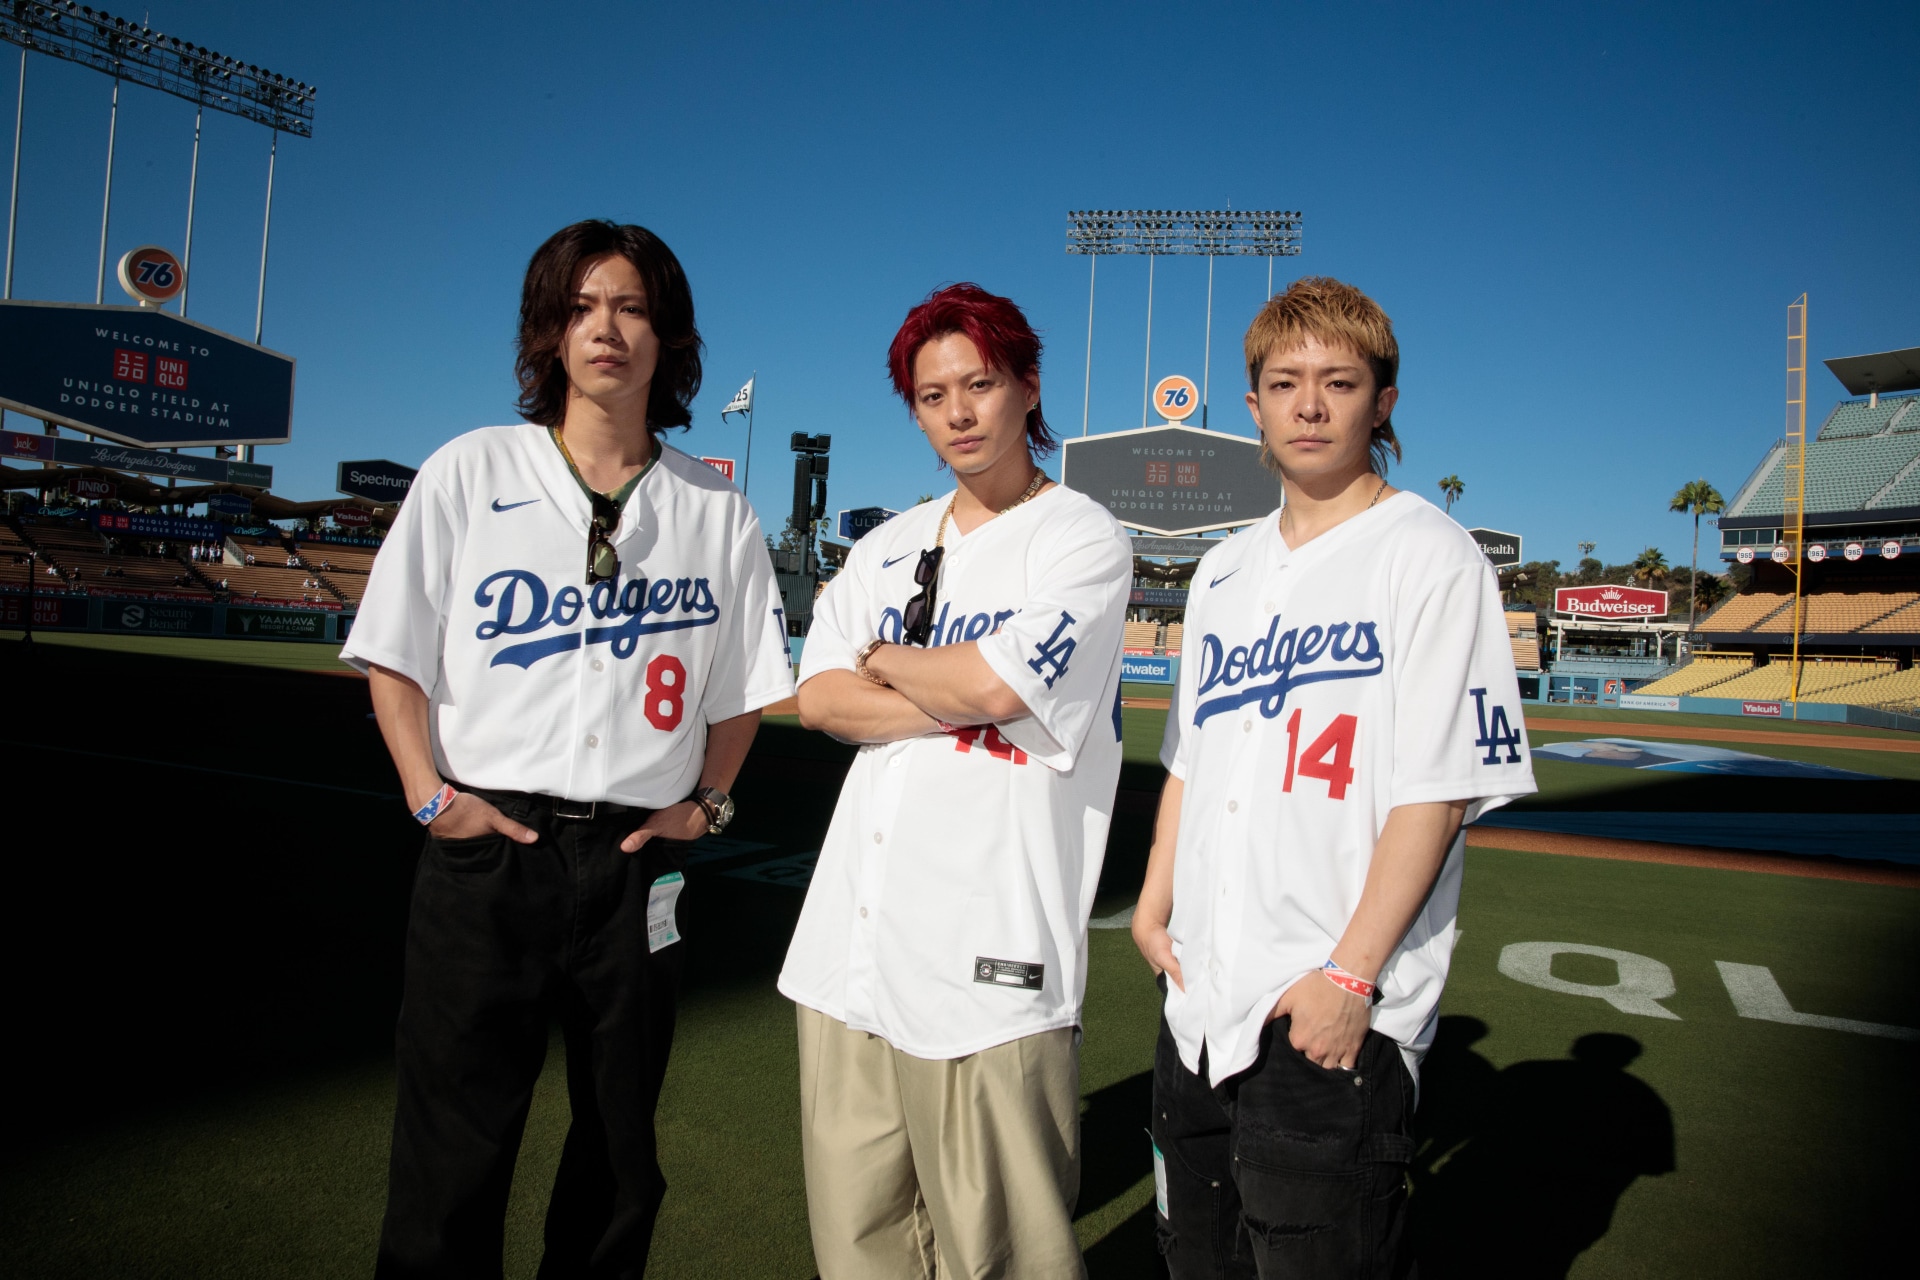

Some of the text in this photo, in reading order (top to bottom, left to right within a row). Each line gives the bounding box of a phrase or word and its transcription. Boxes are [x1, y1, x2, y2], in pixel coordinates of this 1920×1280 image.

[137, 260, 175, 288] 76
[95, 328, 210, 357] WELCOME TO
[159, 360, 183, 374] UNI
[159, 372, 185, 387] QLO
[63, 377, 230, 413] UNIQLO FIELD AT
[1162, 387, 1190, 408] 76
[60, 393, 230, 428] DODGER STADIUM
[14, 436, 39, 451] Jack
[1132, 447, 1215, 457] WELCOME TO
[91, 448, 197, 475] Los Angeles Dodgers
[350, 470, 411, 488] Spectrum
[77, 480, 110, 495] JINRO
[1111, 489, 1164, 499] UNIQLO
[1172, 491, 1209, 500] FIELD
[1110, 501, 1232, 512] DODGER STADIUM
[132, 517, 169, 527] UNIQLO
[174, 522, 199, 530] FIELD
[335, 513, 369, 523] Yakult
[131, 525, 215, 539] DODGER STADIUM
[325, 535, 359, 544] UNIQLO
[1478, 543, 1515, 555] Health
[1883, 546, 1899, 554] 1981
[34, 600, 57, 612] UNI
[149, 605, 196, 620] Security
[474, 562, 720, 662] Dodgers
[34, 611, 58, 624] QLO
[149, 618, 189, 630] Benefit
[1688, 633, 1703, 641] 5:00
[1027, 610, 1077, 691] LA
[1195, 613, 1384, 722] Dodgers
[644, 653, 687, 732] 8
[1744, 704, 1780, 714] Yakult
[1469, 687, 1521, 765] LA
[1282, 708, 1358, 800] 14
